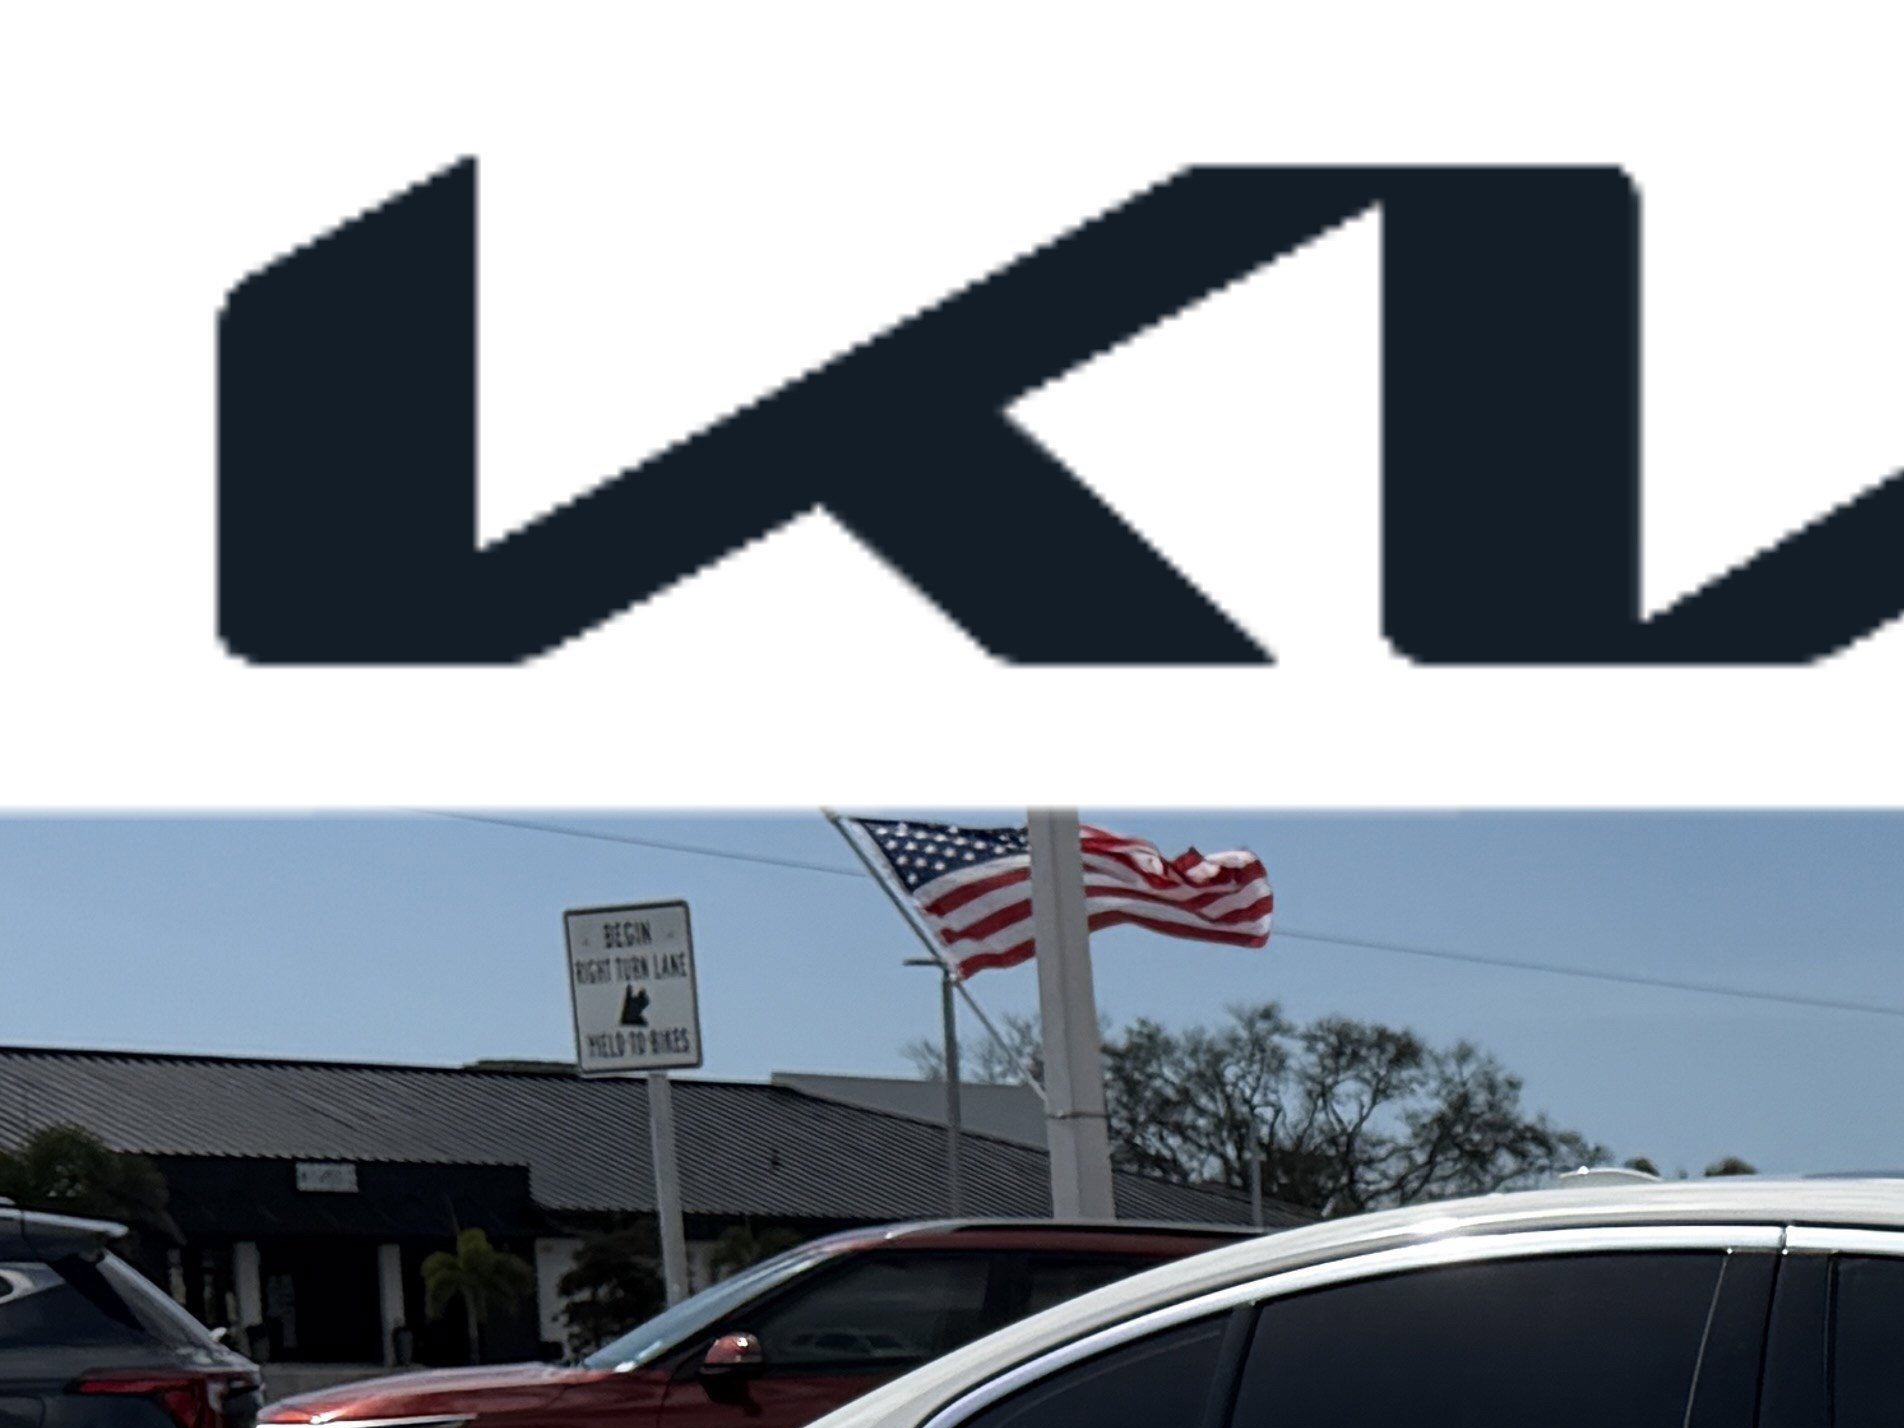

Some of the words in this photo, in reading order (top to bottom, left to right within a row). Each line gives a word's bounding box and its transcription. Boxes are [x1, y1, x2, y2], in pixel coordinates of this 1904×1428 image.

[603, 920, 652, 949] BEGIN
[575, 958, 611, 984] RIGHT
[615, 956, 649, 981] TURN
[652, 952, 687, 980] LANE
